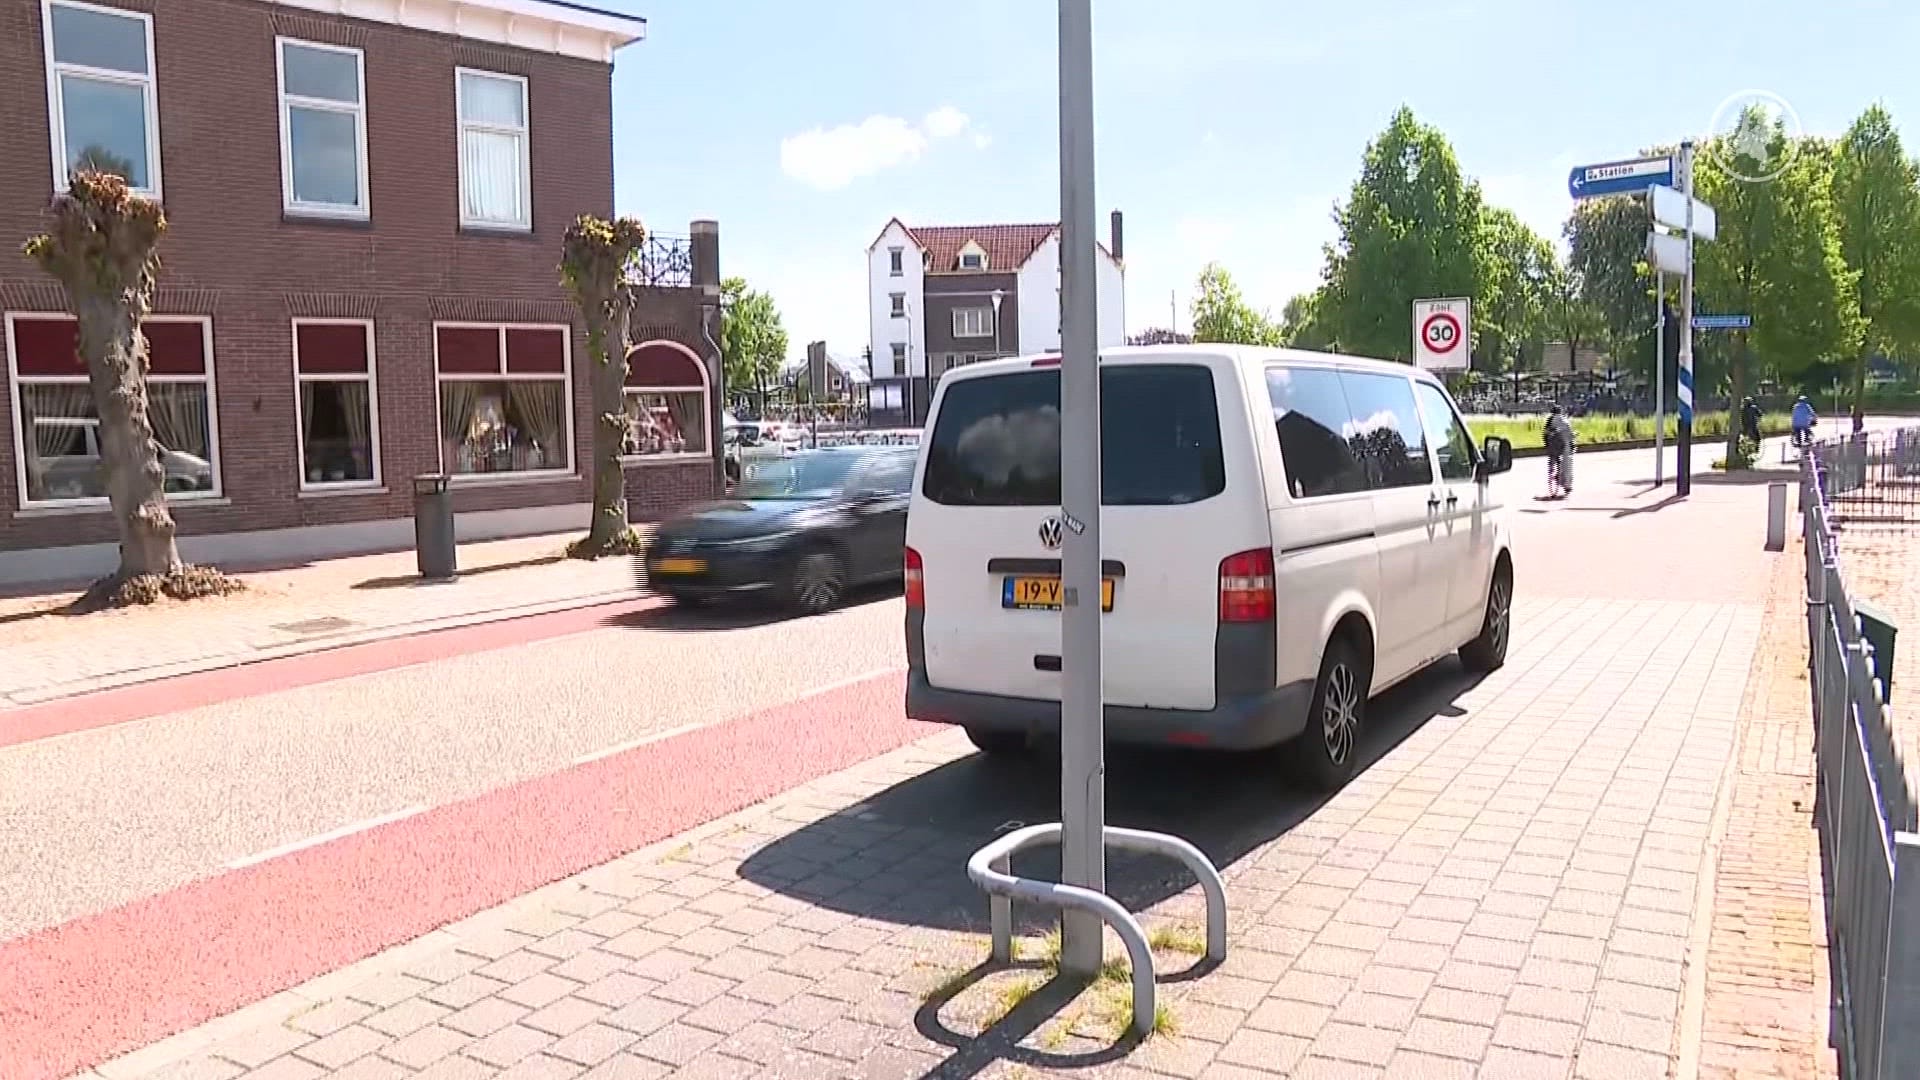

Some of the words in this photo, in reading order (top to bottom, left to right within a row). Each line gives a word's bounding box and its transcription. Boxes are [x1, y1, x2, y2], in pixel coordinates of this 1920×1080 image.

[1599, 166, 1634, 178] Station
[1430, 325, 1453, 341] 30
[1023, 581, 1061, 601] 19-V
